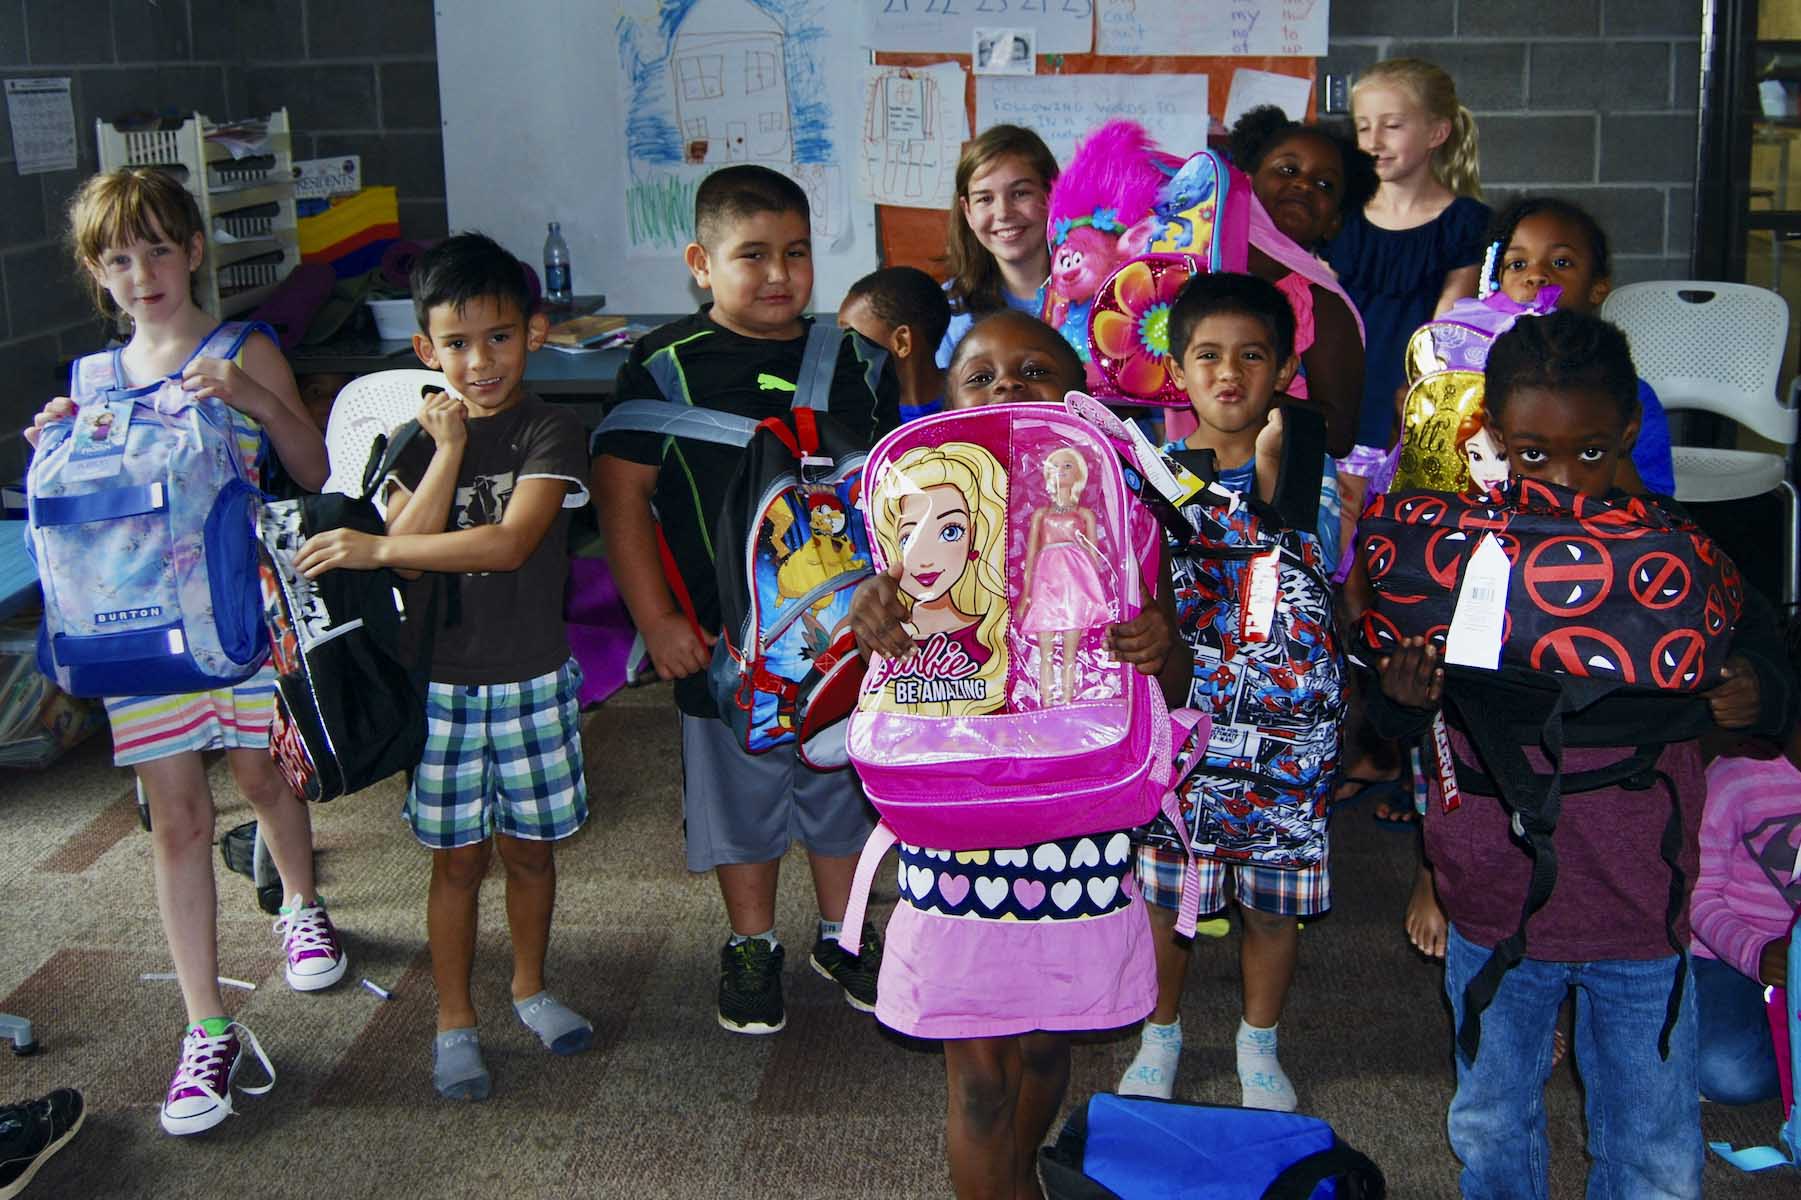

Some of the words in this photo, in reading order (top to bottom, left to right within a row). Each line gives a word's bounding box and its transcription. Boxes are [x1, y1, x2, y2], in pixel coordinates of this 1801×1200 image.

[98, 607, 160, 623] BURTON
[895, 681, 919, 704] BE
[922, 679, 987, 703] AMAZING
